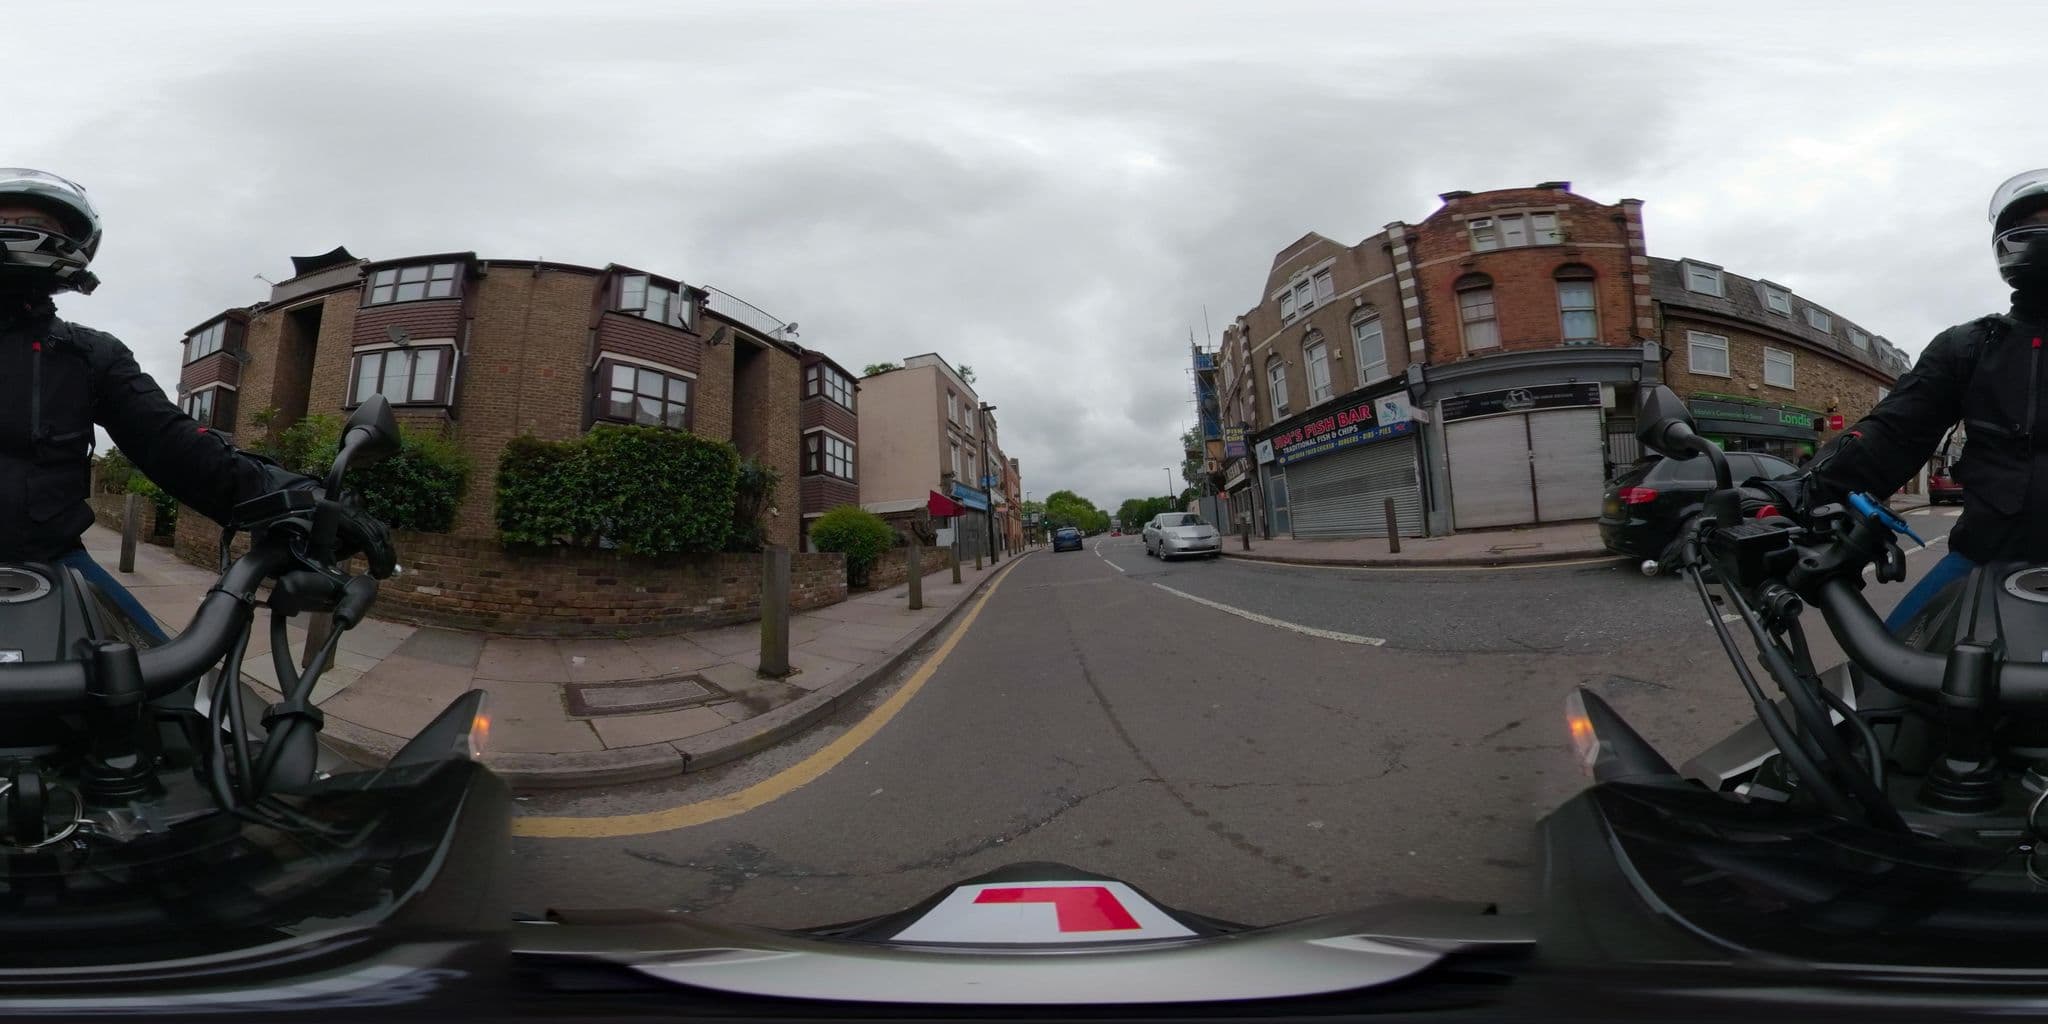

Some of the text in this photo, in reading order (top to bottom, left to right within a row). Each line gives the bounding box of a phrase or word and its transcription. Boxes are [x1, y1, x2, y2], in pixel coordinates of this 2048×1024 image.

[1272, 404, 1372, 449] JIM'S FISH BAR
[1778, 409, 1812, 427] Londis
[1283, 425, 1359, 454] TRADITIONAL FISH & CHIPS
